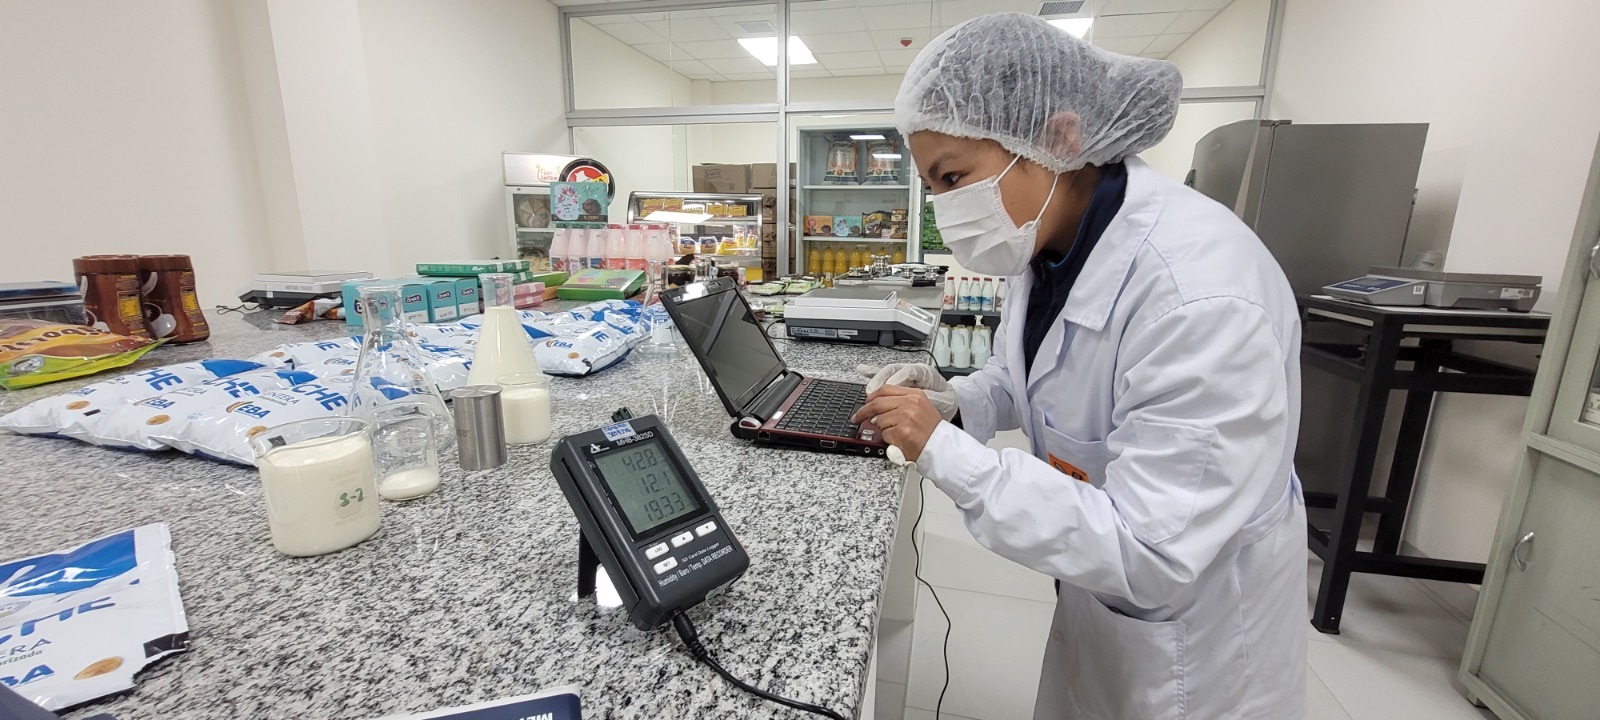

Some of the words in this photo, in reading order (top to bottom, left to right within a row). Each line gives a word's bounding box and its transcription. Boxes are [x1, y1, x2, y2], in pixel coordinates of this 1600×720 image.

[552, 339, 573, 349] EBA
[238, 403, 271, 419] EBA
[658, 573, 679, 587] Humidity
[701, 555, 713, 566] DATA
